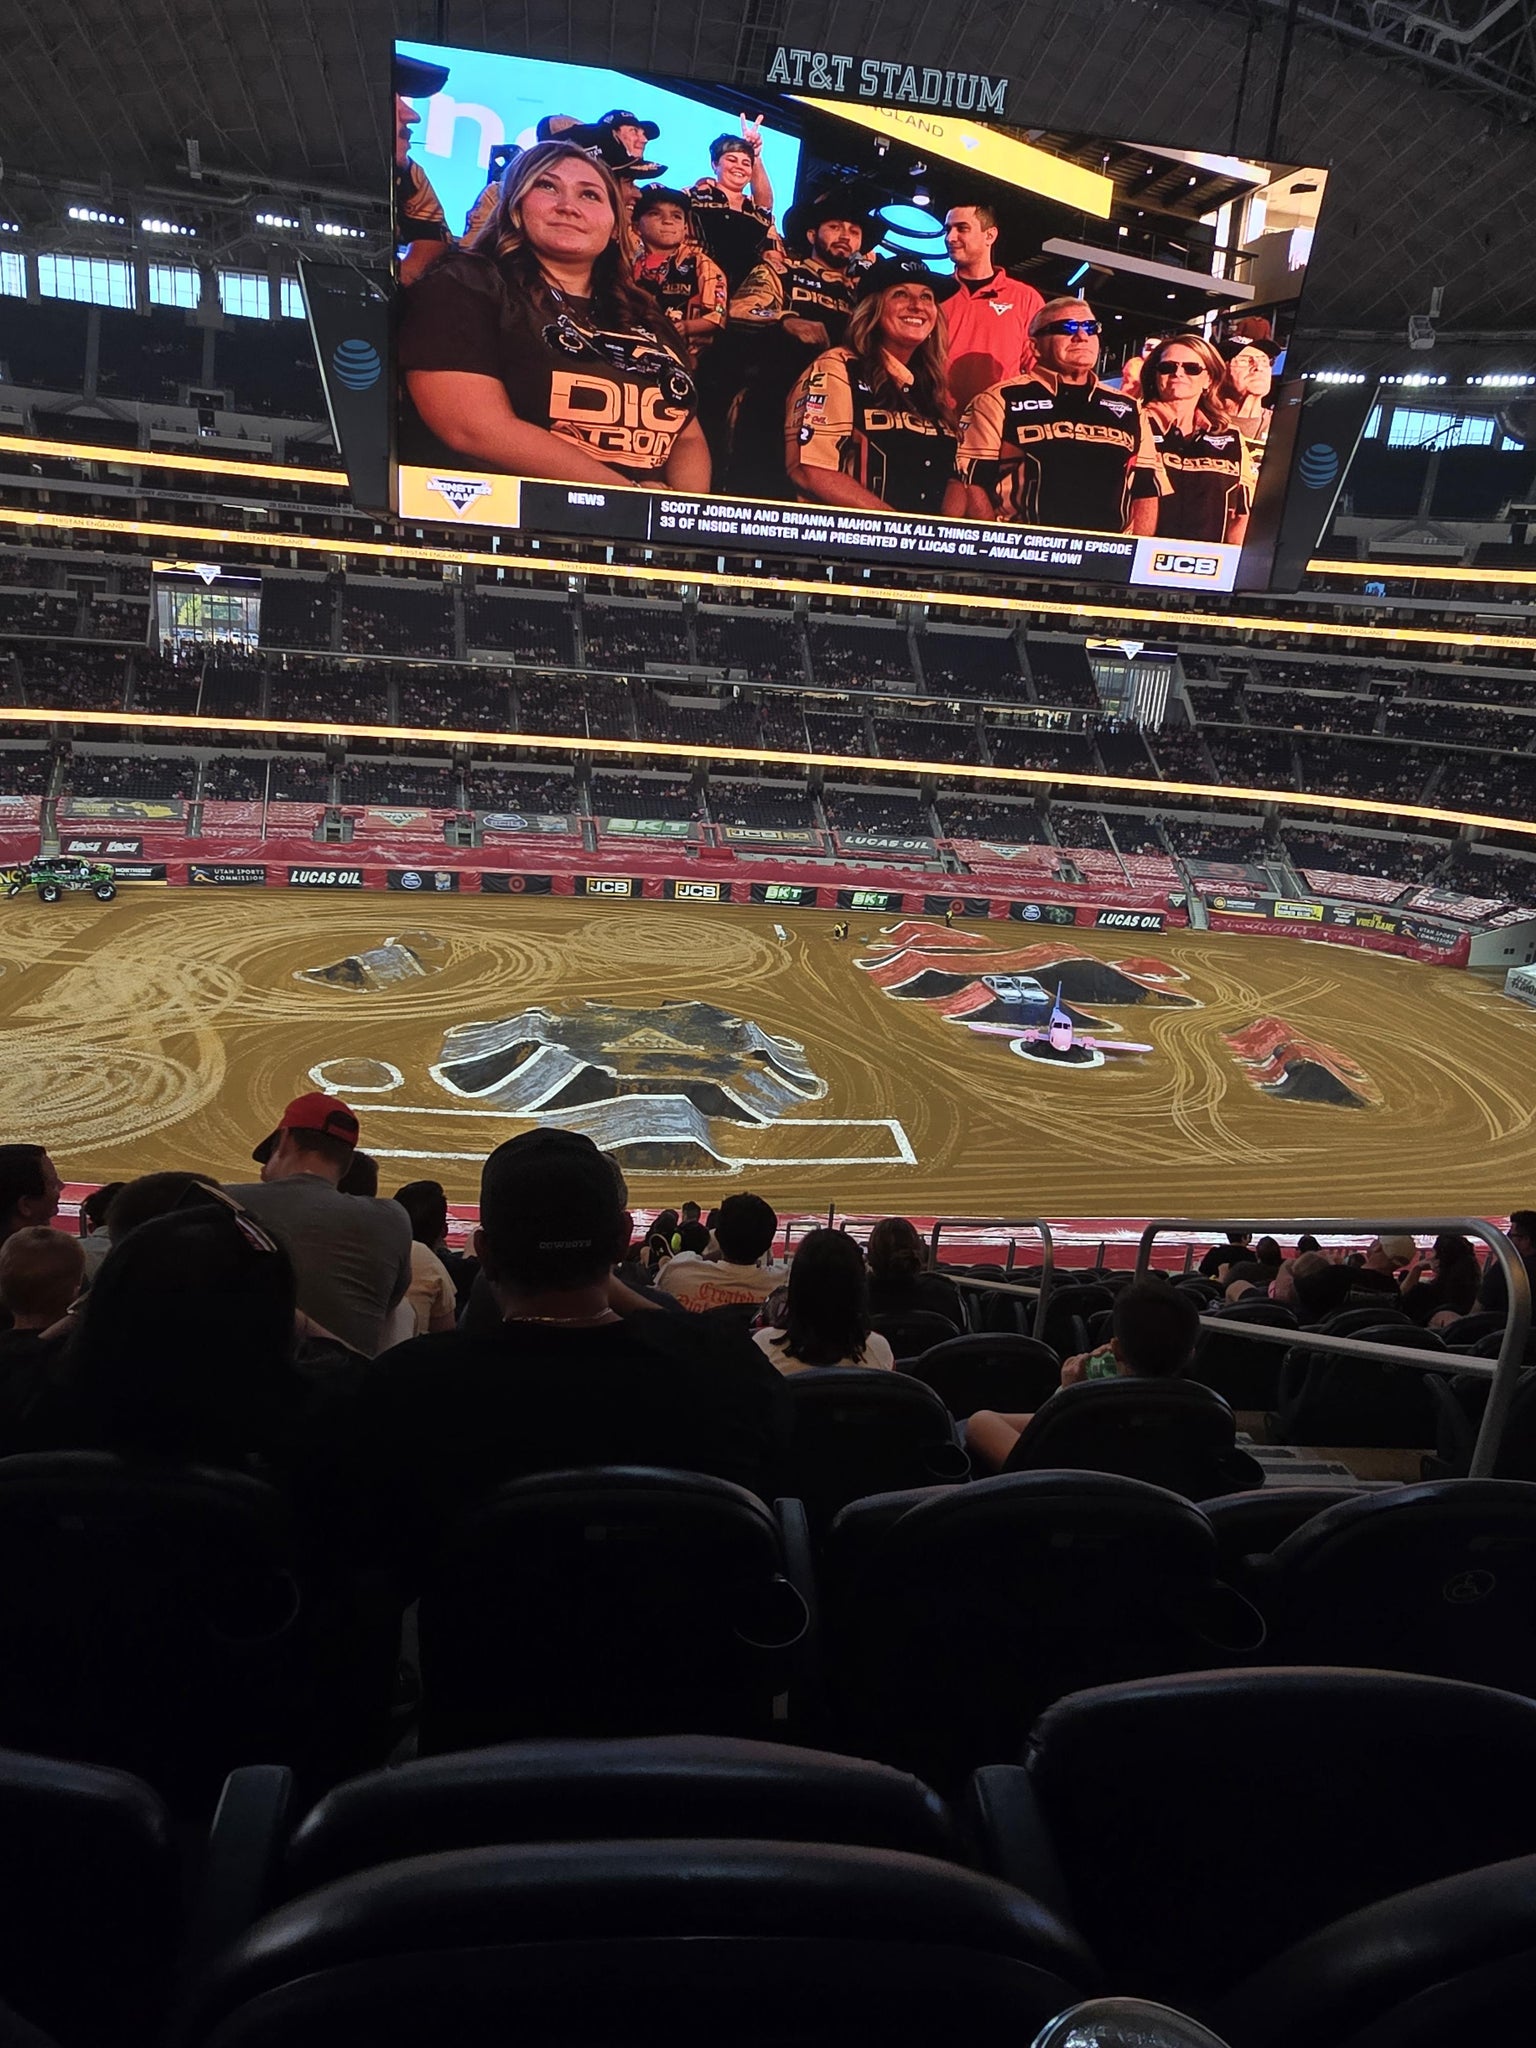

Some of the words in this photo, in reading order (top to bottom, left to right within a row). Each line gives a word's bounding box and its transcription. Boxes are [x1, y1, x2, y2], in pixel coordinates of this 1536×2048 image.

[767, 47, 853, 91] AT&T
[859, 59, 1008, 115] STADIUM
[873, 106, 944, 137] GLAND
[1011, 400, 1053, 412] JCB
[568, 492, 605, 506] NEWS
[278, 503, 306, 511] DARREN
[307, 505, 341, 514] WOODSON
[660, 501, 701, 516] SCOTT
[702, 505, 751, 520] JORDAN
[753, 510, 780, 523] AND
[782, 512, 835, 528] BRIANNA
[837, 517, 882, 532] MAHON
[884, 521, 912, 535] TALK
[913, 524, 936, 537] ALL
[938, 526, 980, 542] THINGS
[982, 531, 1023, 546] BAILEY
[1024, 534, 1069, 550] CIRCUIT
[1070, 538, 1083, 551] IN
[1085, 540, 1133, 556] EPISODE
[660, 516, 676, 528] 33
[679, 517, 695, 529] OF
[698, 519, 738, 534] INSIDE
[741, 523, 799, 540] MONSTER
[801, 529, 827, 542] JAM
[830, 531, 898, 548] PRESENTED
[901, 538, 917, 550] BY
[918, 540, 956, 554] LUCAS
[958, 543, 977, 555] OIL
[989, 546, 1049, 562] AVAILABLE
[1050, 551, 1082, 565] NOW!
[1155, 554, 1217, 575] JCB
[845, 836, 900, 848] LUCAS
[902, 840, 930, 849] OIL
[290, 870, 337, 884] LUCAS
[338, 872, 362, 885] OIL
[589, 881, 628, 893] JCB
[678, 885, 716, 897] JCB
[1099, 913, 1139, 927] LUCAS
[1140, 915, 1161, 928] OIL
